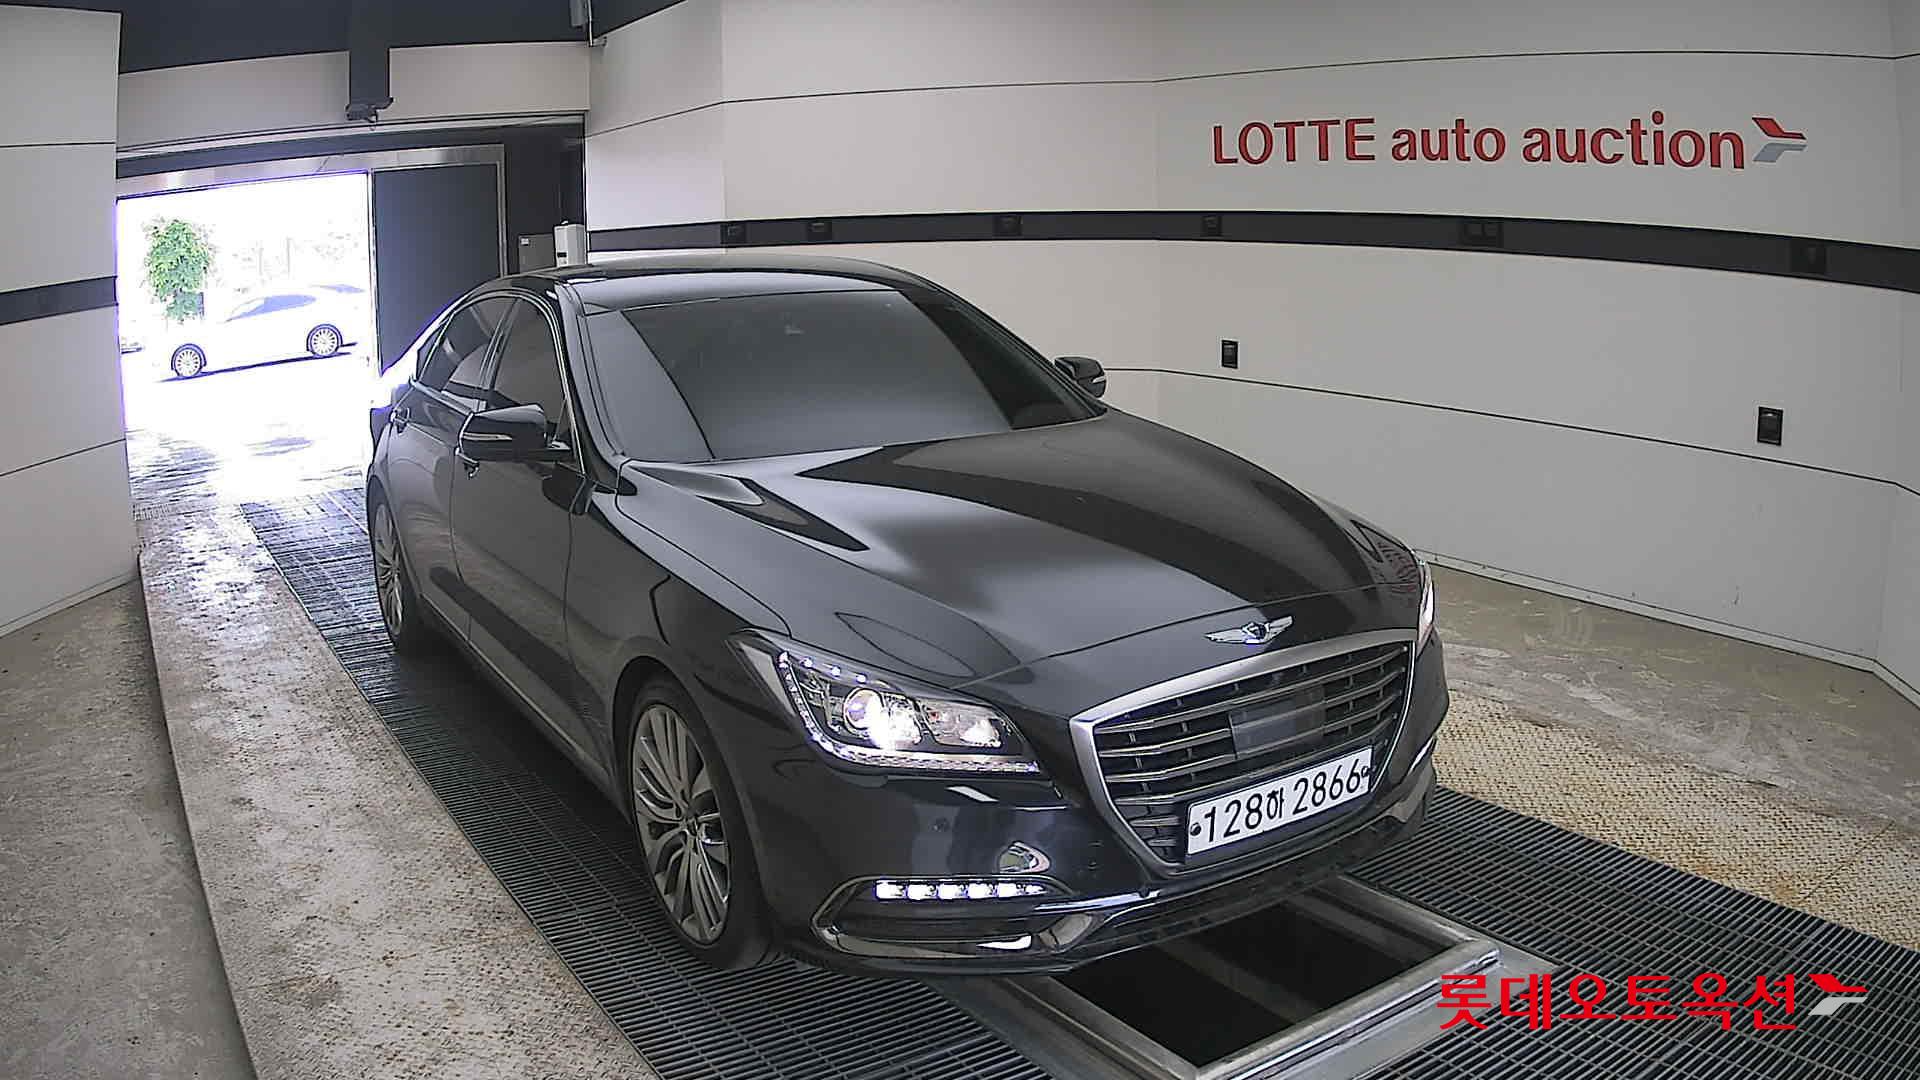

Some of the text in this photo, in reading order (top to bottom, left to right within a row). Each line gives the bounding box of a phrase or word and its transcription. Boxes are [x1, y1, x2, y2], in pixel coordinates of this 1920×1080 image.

[1213, 111, 1746, 170] LOTTE auto auction
[1292, 758, 1361, 815] 2866
